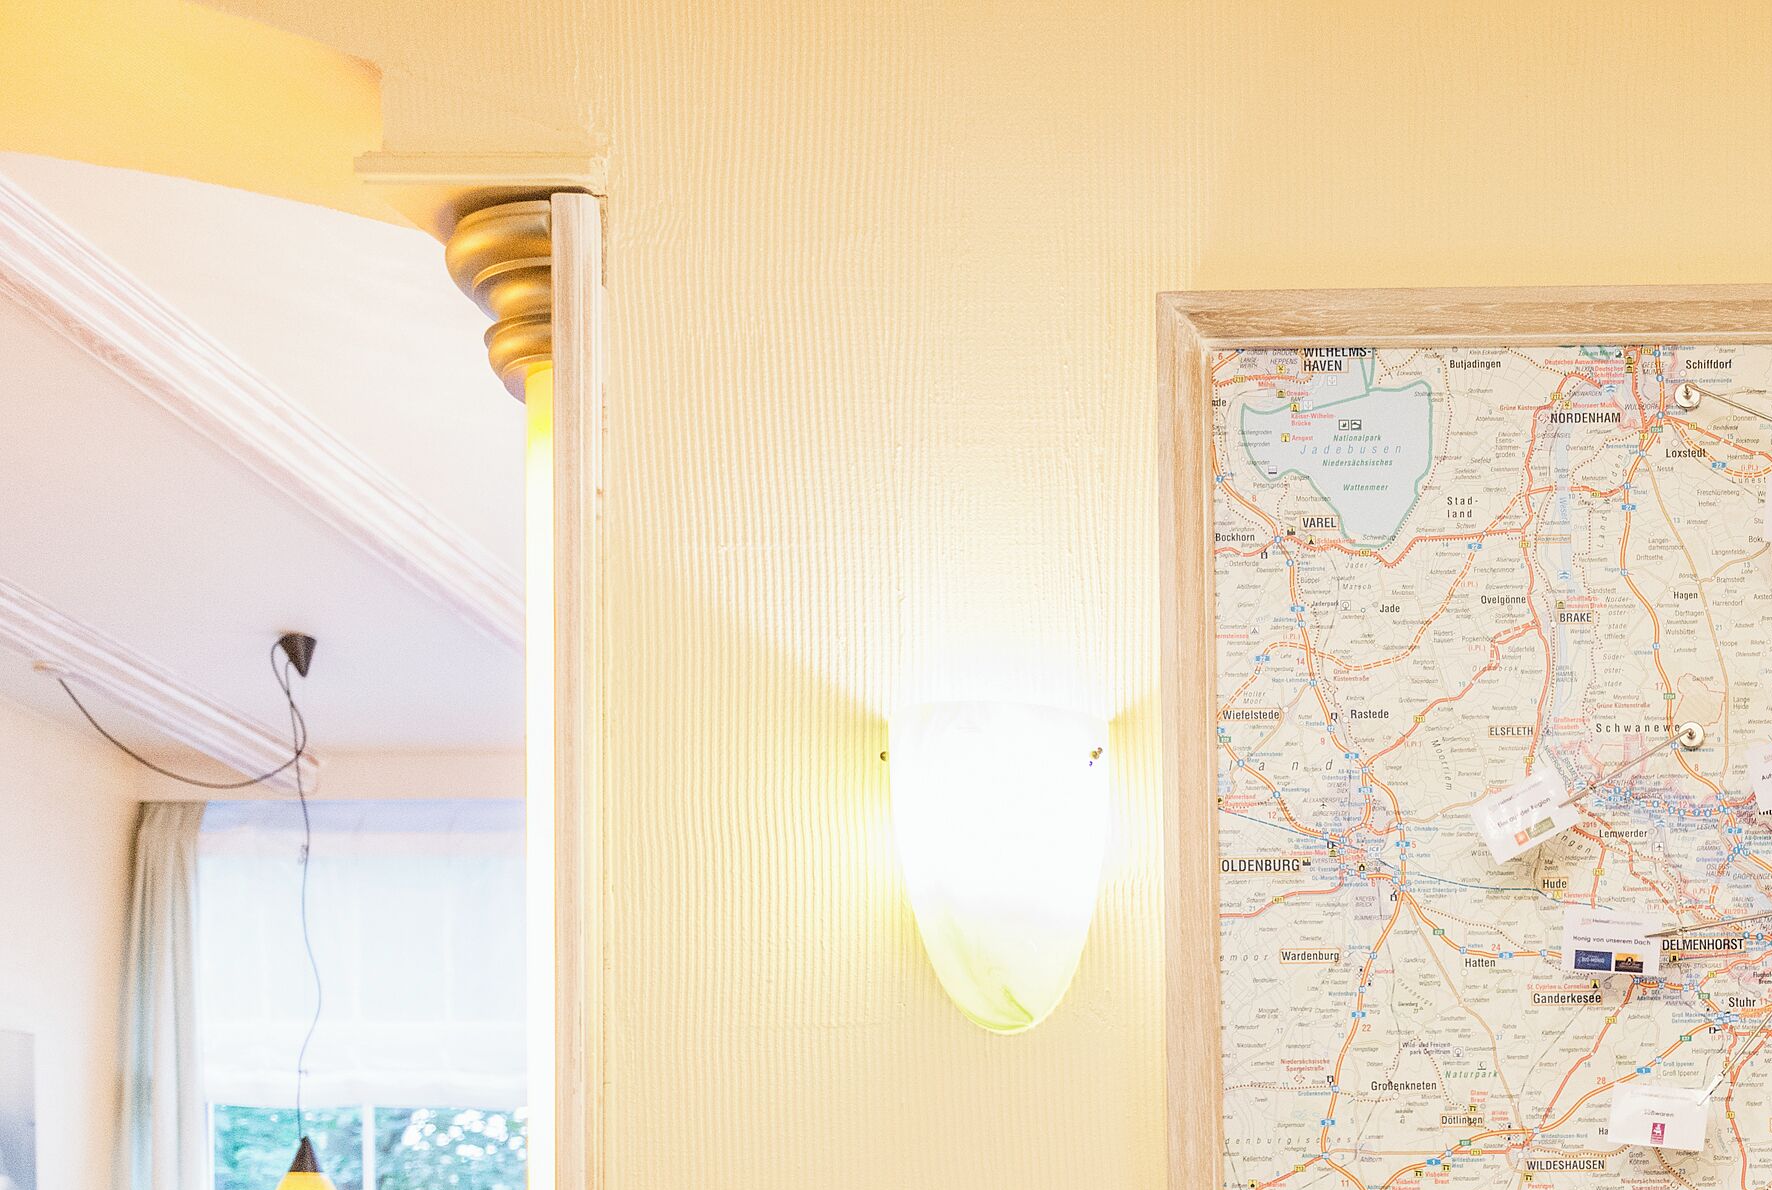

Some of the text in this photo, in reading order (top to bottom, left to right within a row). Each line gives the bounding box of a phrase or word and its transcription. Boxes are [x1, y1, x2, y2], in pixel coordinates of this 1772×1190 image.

[1304, 347, 1372, 356] WILHELMS-
[1304, 360, 1342, 371] HAVEN
[1449, 360, 1501, 369] Butjadingen
[1686, 360, 1732, 370] Schiffdorf
[1550, 413, 1621, 423] NORDENHAM
[1333, 434, 1381, 442] Nationalpark
[1666, 449, 1706, 458] Loxstedt
[1322, 459, 1393, 467] Niedersächsisches
[1447, 497, 1478, 505] Stad-
[1447, 510, 1472, 518] land
[1303, 518, 1336, 528] VAREL
[1215, 533, 1255, 542] Bockhorn
[1481, 595, 1526, 604] Ovelgönne
[1673, 591, 1698, 600] Hagen
[1380, 604, 1400, 613] Jade
[1560, 613, 1591, 622] BRAKE
[1223, 710, 1279, 720] Wiefelstede
[1350, 709, 1388, 719] Rastede
[1490, 727, 1533, 736] ELSFLETH
[1599, 830, 1647, 838] Lemwerder
[1222, 860, 1300, 871] OLDENBURG
[1543, 879, 1567, 888] Hude
[1663, 939, 1743, 950] DELMENHORST
[1281, 951, 1339, 962] Wardenburg
[1465, 958, 1495, 968] Hatten
[1533, 994, 1600, 1004] Ganderkesee
[1729, 998, 1756, 1007] Stuhr
[1445, 1070, 1498, 1079] Naturpark
[1371, 1081, 1437, 1091] Großenkneten
[1527, 1160, 1604, 1170] WILDESHAUSEN
